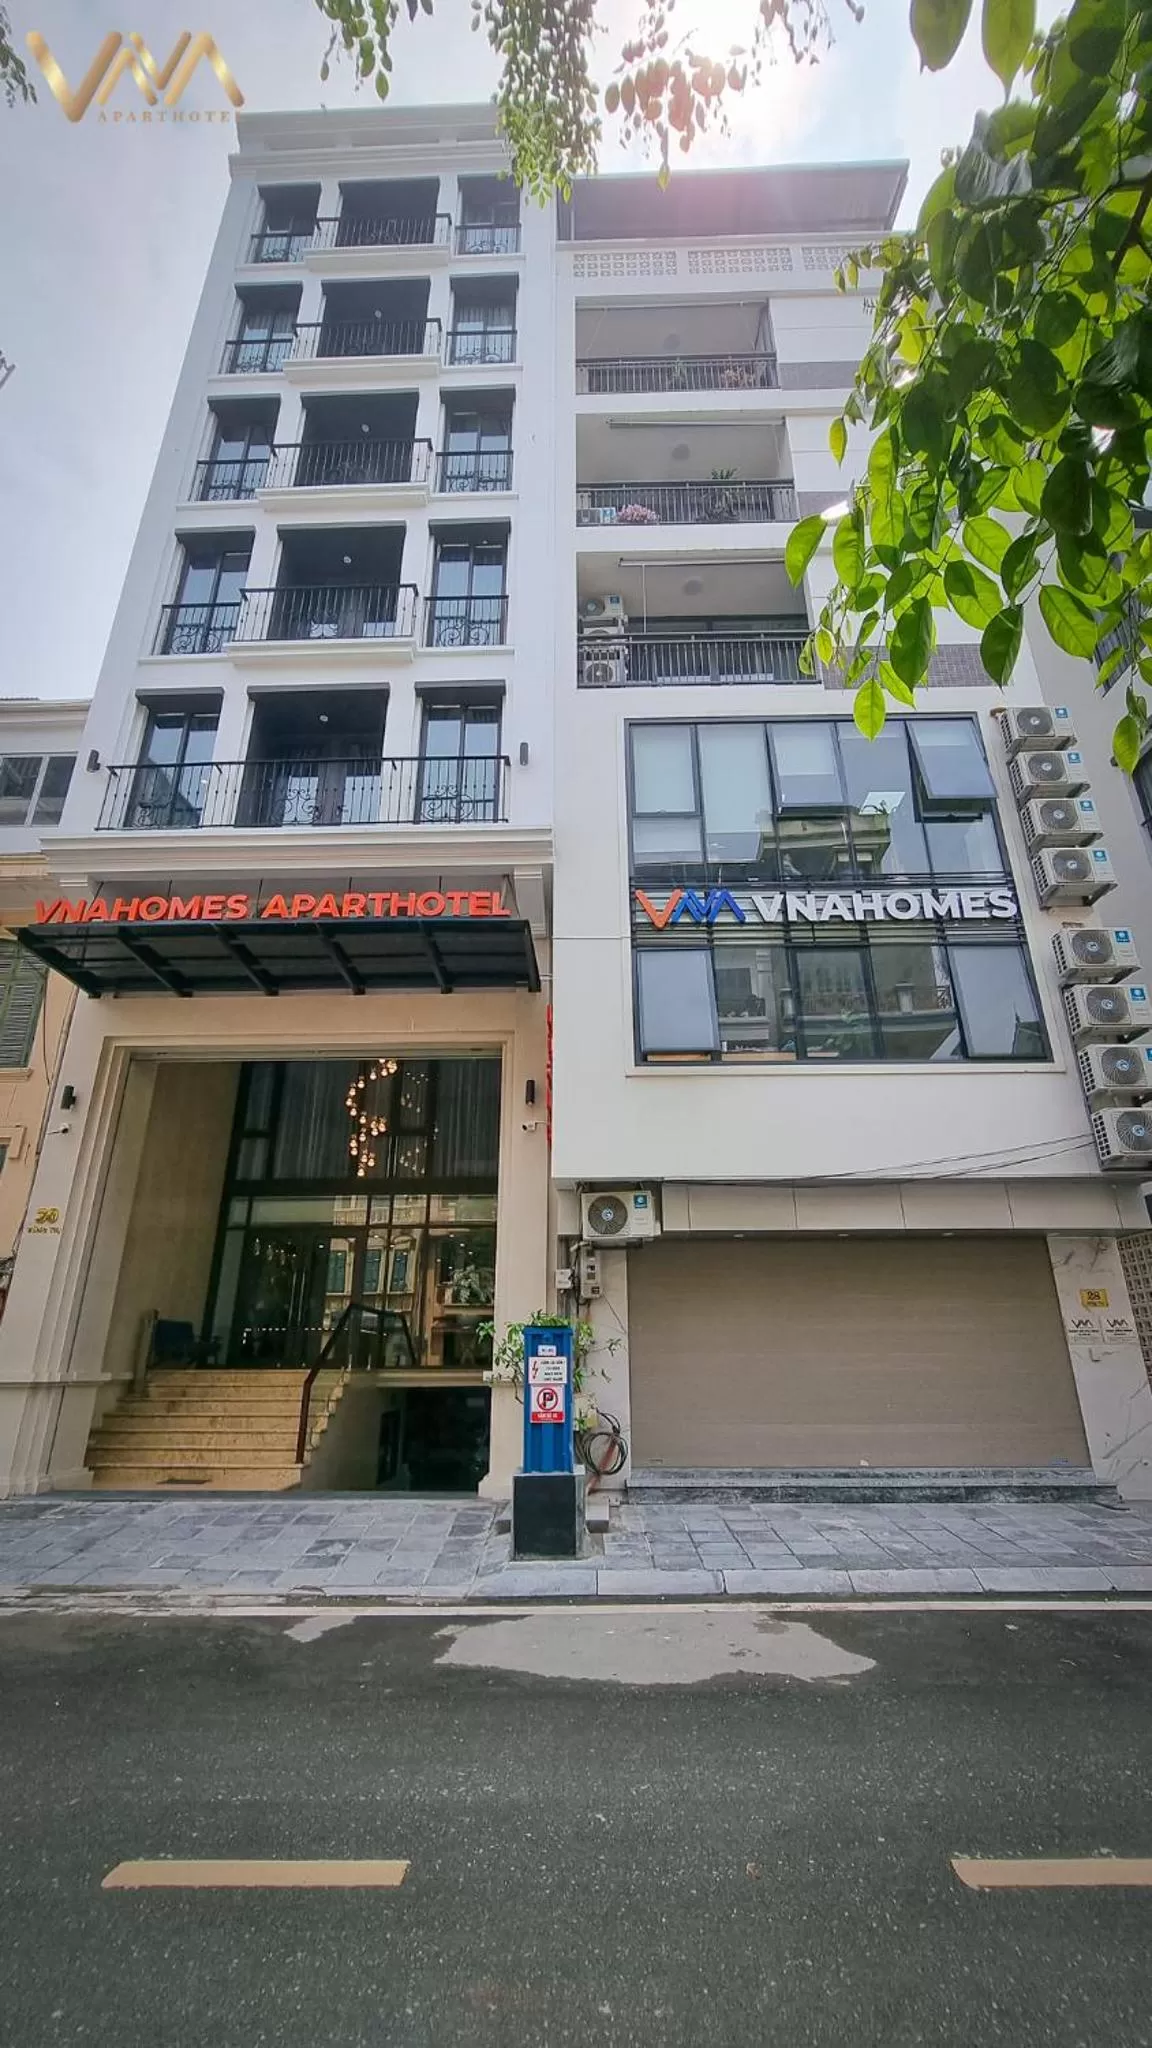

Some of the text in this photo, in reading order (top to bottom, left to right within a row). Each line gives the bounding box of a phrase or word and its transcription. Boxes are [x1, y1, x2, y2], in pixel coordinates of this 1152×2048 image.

[34, 890, 512, 925] VNAHOMES APARTHOTEL
[753, 888, 1017, 922] VNAHOMES
